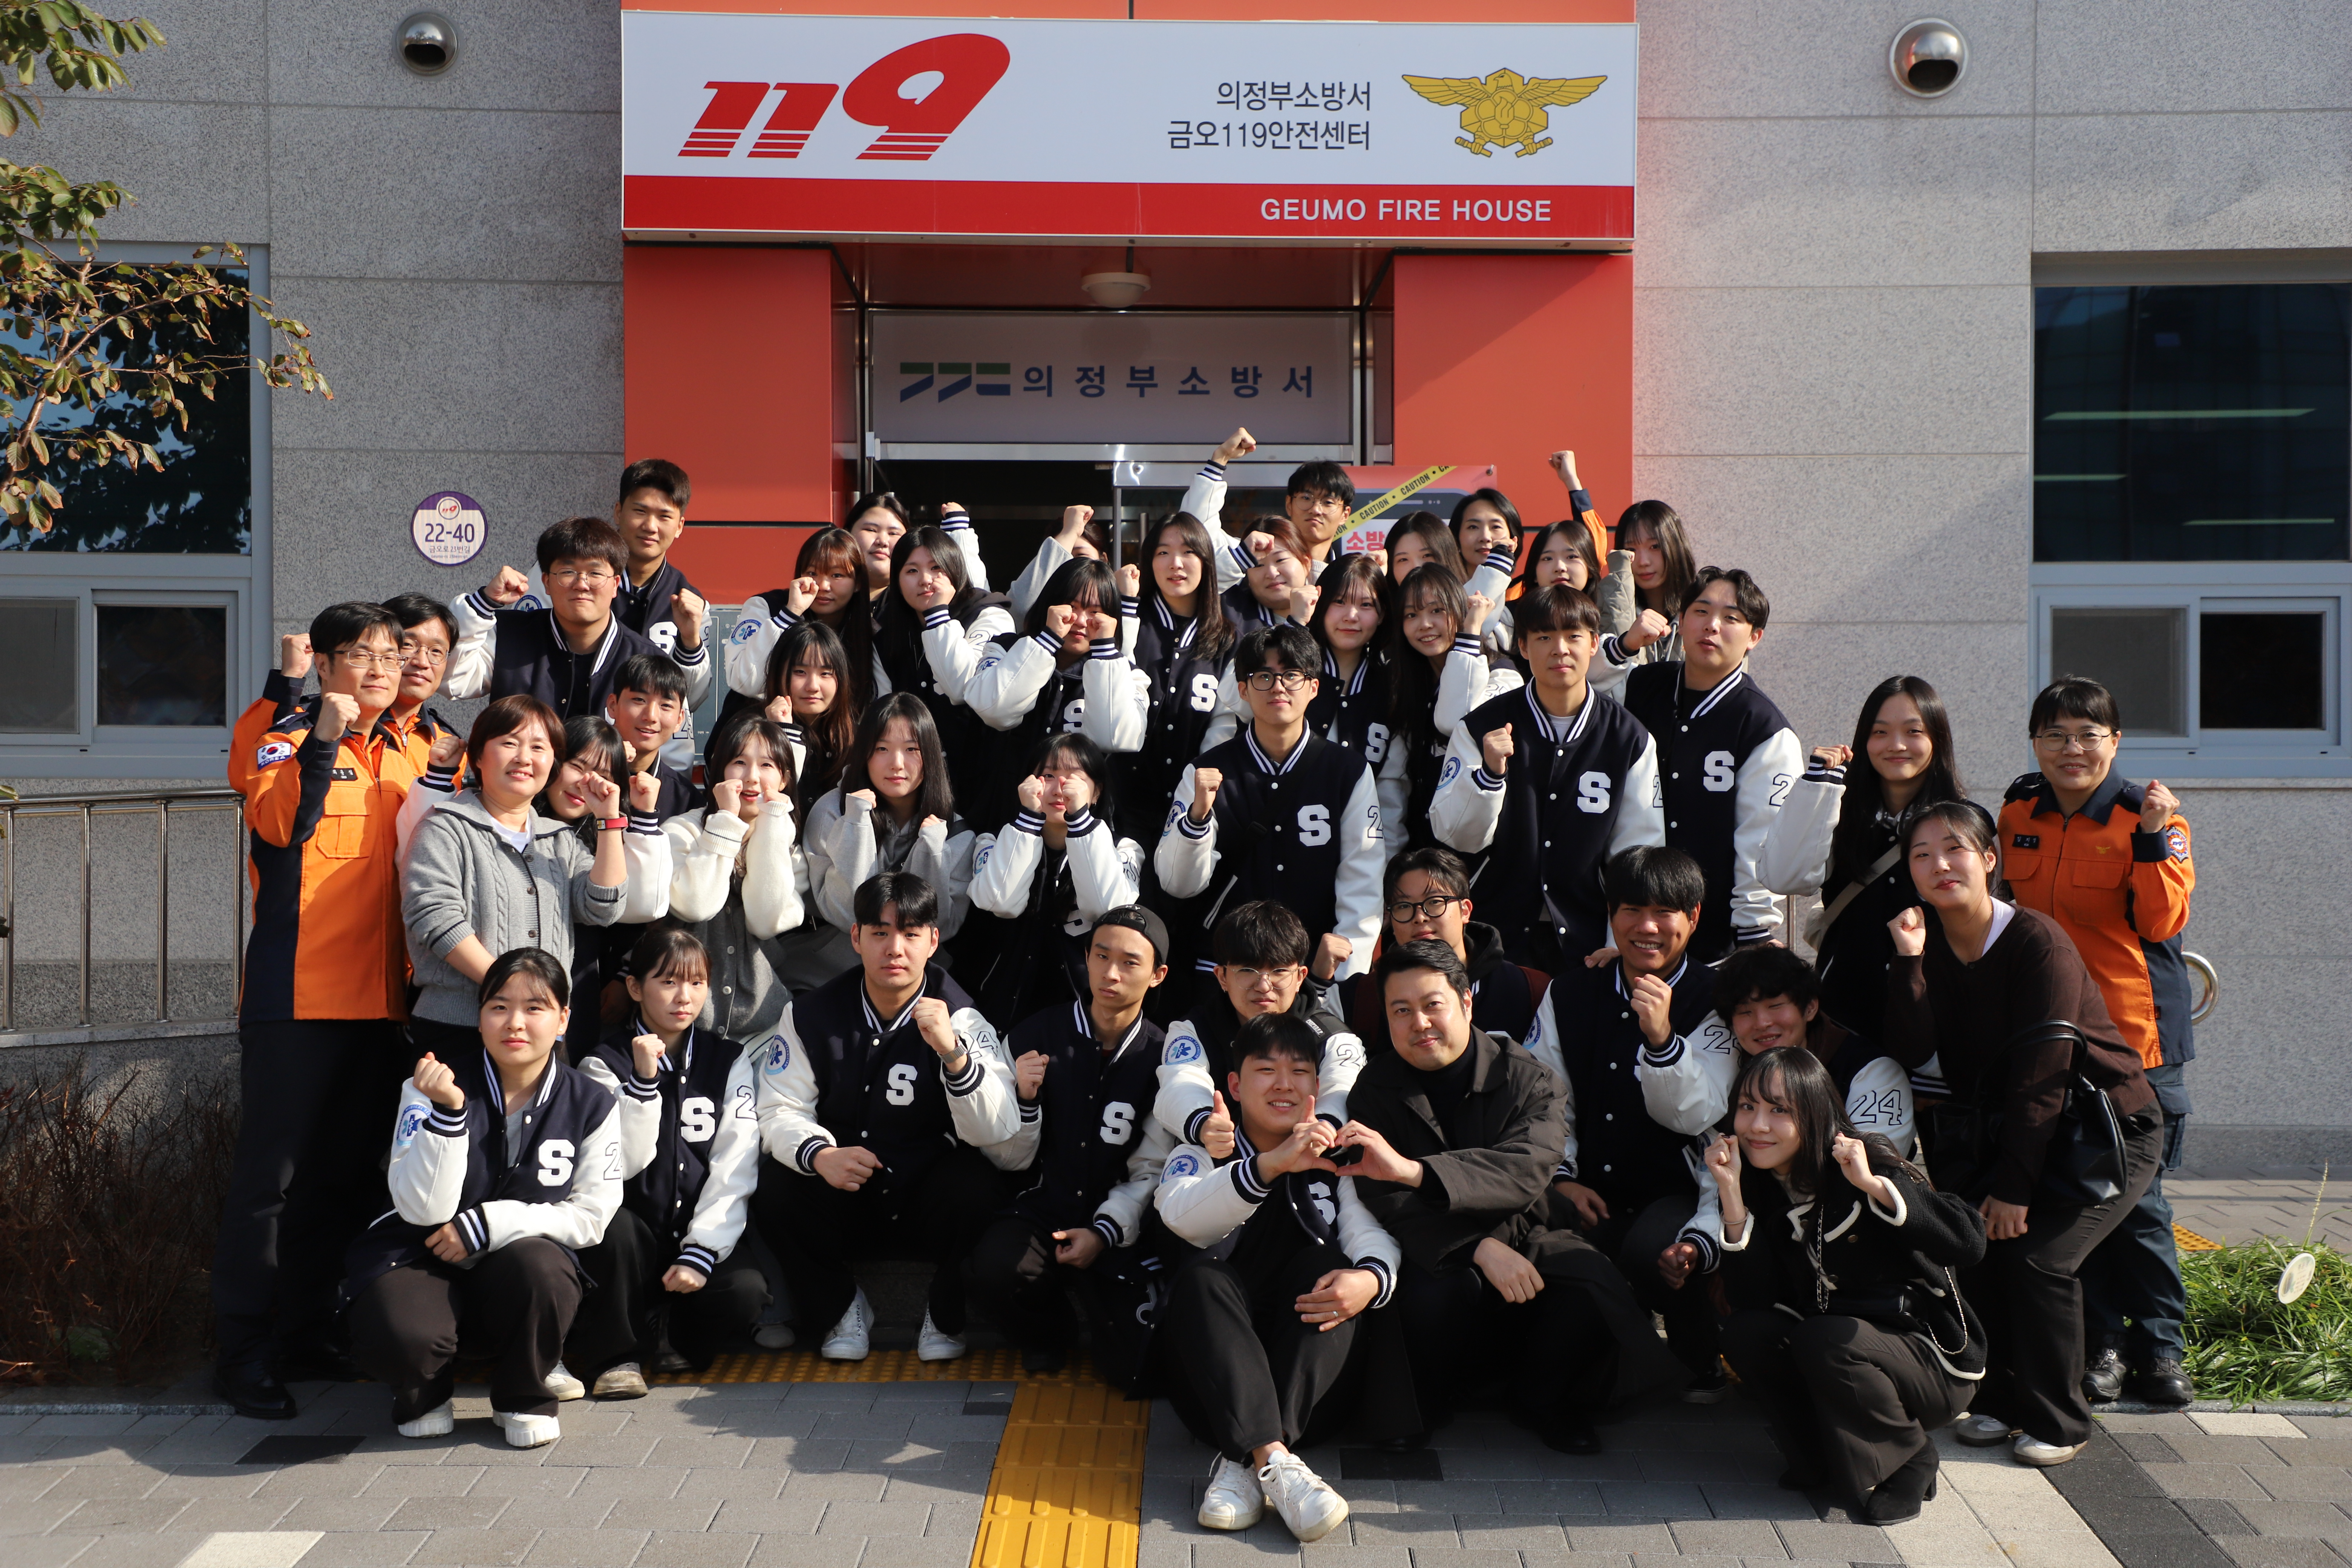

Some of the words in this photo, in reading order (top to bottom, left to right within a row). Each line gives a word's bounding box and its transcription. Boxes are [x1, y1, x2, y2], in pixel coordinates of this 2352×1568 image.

[678, 33, 1010, 161] 119
[1217, 80, 1370, 111] 의정부소방서
[1168, 121, 1370, 151] 금오119안전센터
[1261, 199, 1366, 221] GEUMO
[1379, 199, 1440, 221] FIRE
[1453, 199, 1551, 222] HOUSE
[1023, 364, 1312, 399] 의정부소방서
[441, 505, 457, 513] 119
[1360, 498, 1389, 520] CAUTION
[1400, 473, 1431, 495] CAUTION
[425, 523, 475, 543] 22-40
[1346, 531, 1386, 551] 소방
[649, 621, 678, 655] S
[1191, 673, 1219, 712] S
[261, 756, 286, 766] KOREA
[1364, 722, 1390, 763] S
[1703, 750, 1735, 792] S
[1577, 771, 1611, 813] S
[1769, 773, 1797, 807] 2
[1297, 804, 1331, 847] S
[1367, 805, 1385, 840] 2
[1337, 1044, 1368, 1071] 2
[1703, 1024, 1741, 1063] 2
[886, 1063, 918, 1106] S
[680, 1096, 715, 1142] S
[1100, 1101, 1136, 1145] S
[1848, 1089, 1902, 1126] 24
[537, 1139, 575, 1187] S
[603, 1142, 622, 1180] 2
